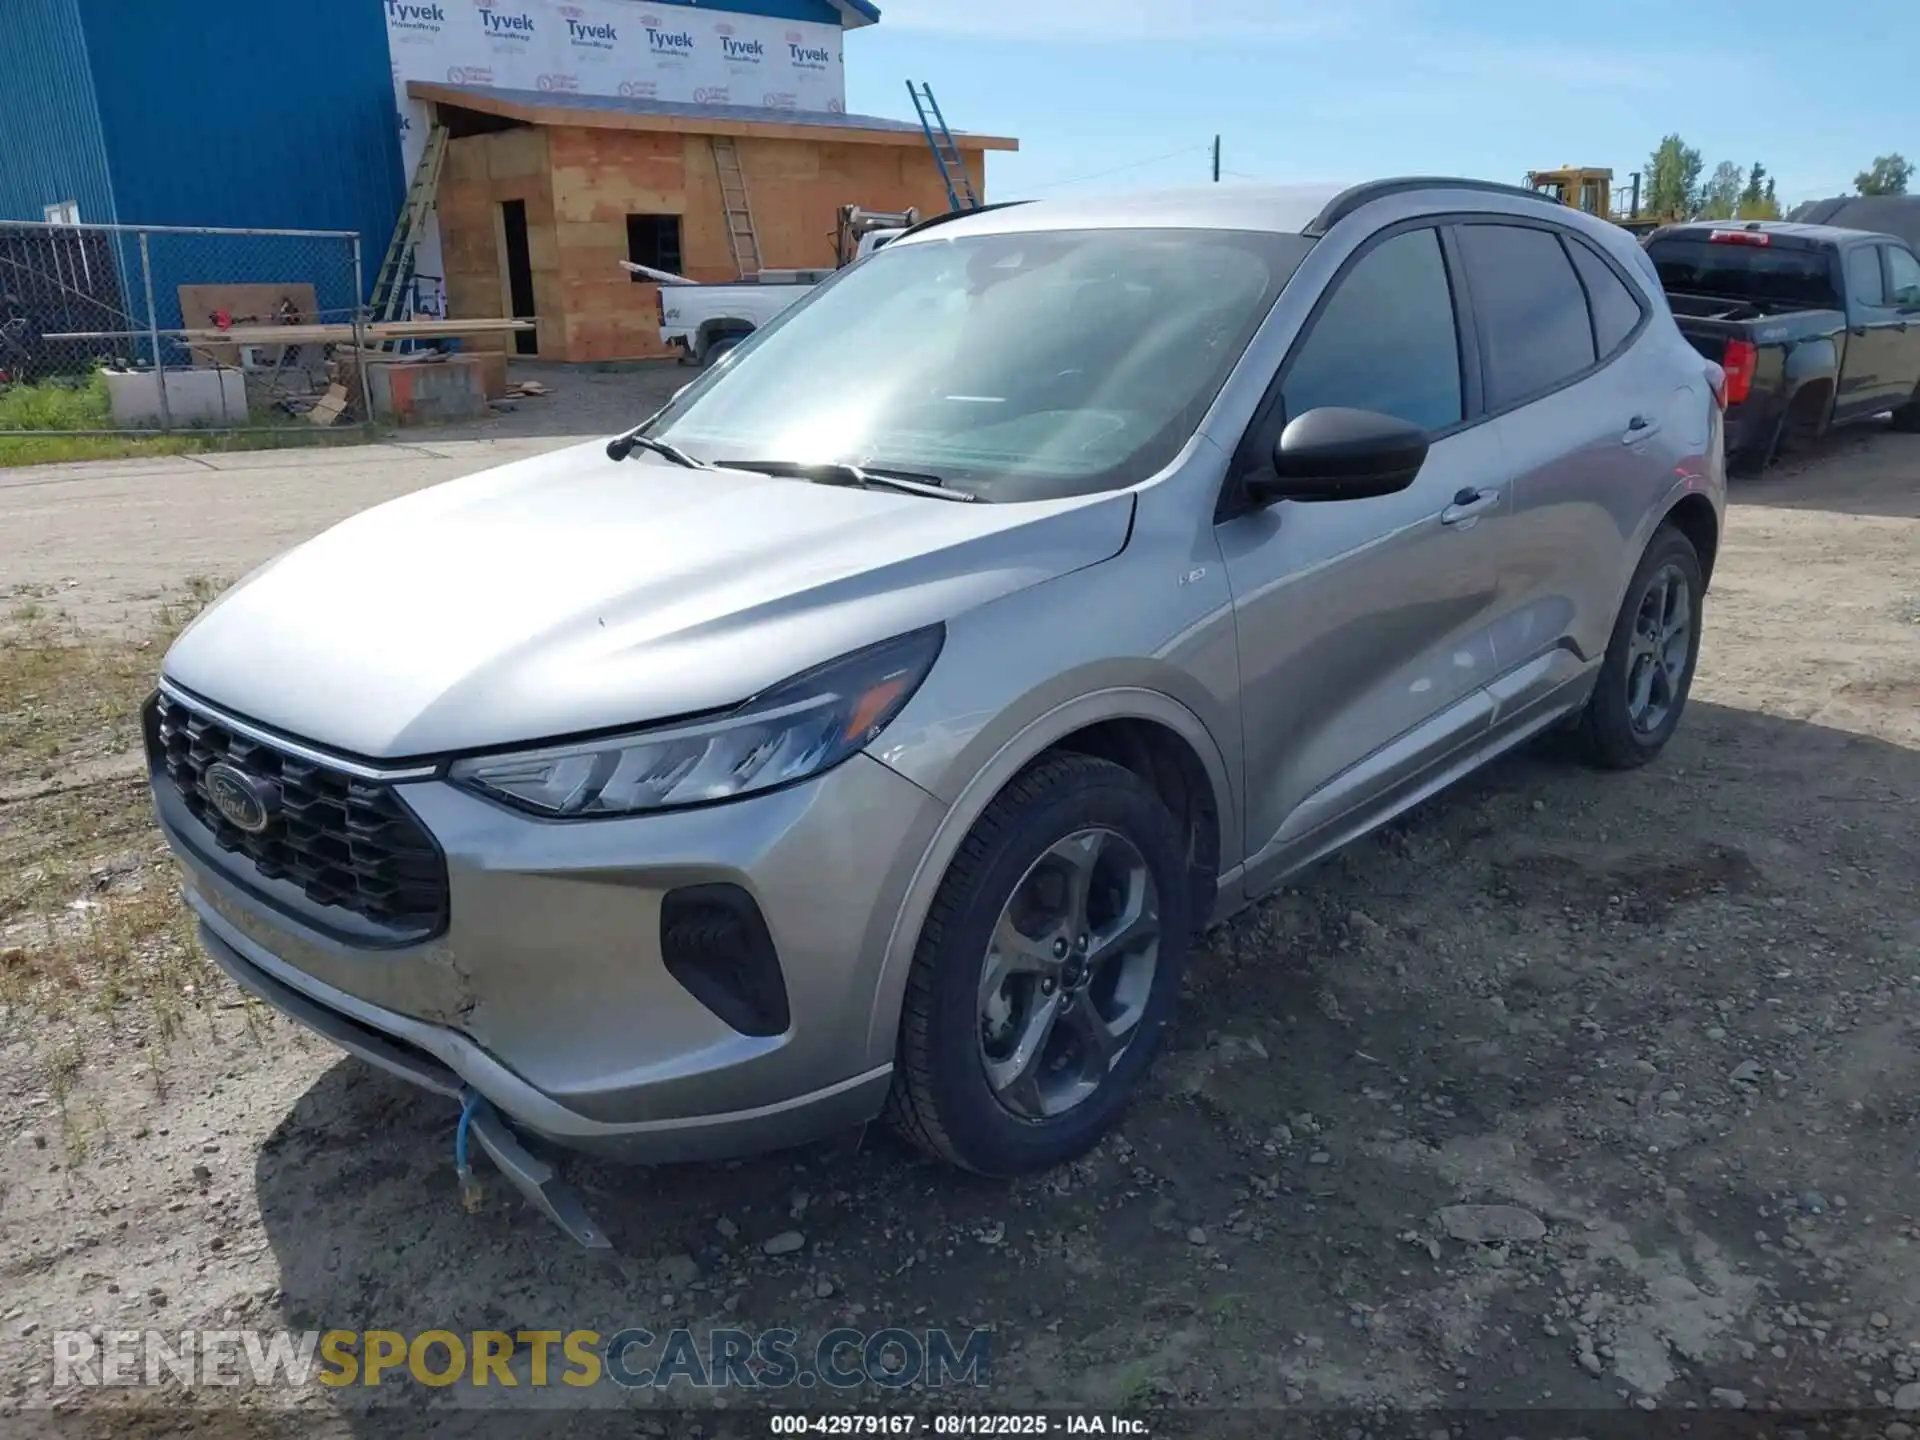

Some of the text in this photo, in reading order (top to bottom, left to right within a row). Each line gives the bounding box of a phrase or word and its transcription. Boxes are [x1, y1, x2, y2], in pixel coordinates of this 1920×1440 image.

[387, 0, 445, 21] Tyvek
[479, 8, 535, 31] Tyvek
[565, 18, 618, 41] Tyvek
[645, 28, 694, 48] Tyvek
[719, 36, 763, 56] Tyvek
[788, 43, 829, 62] Tyvek
